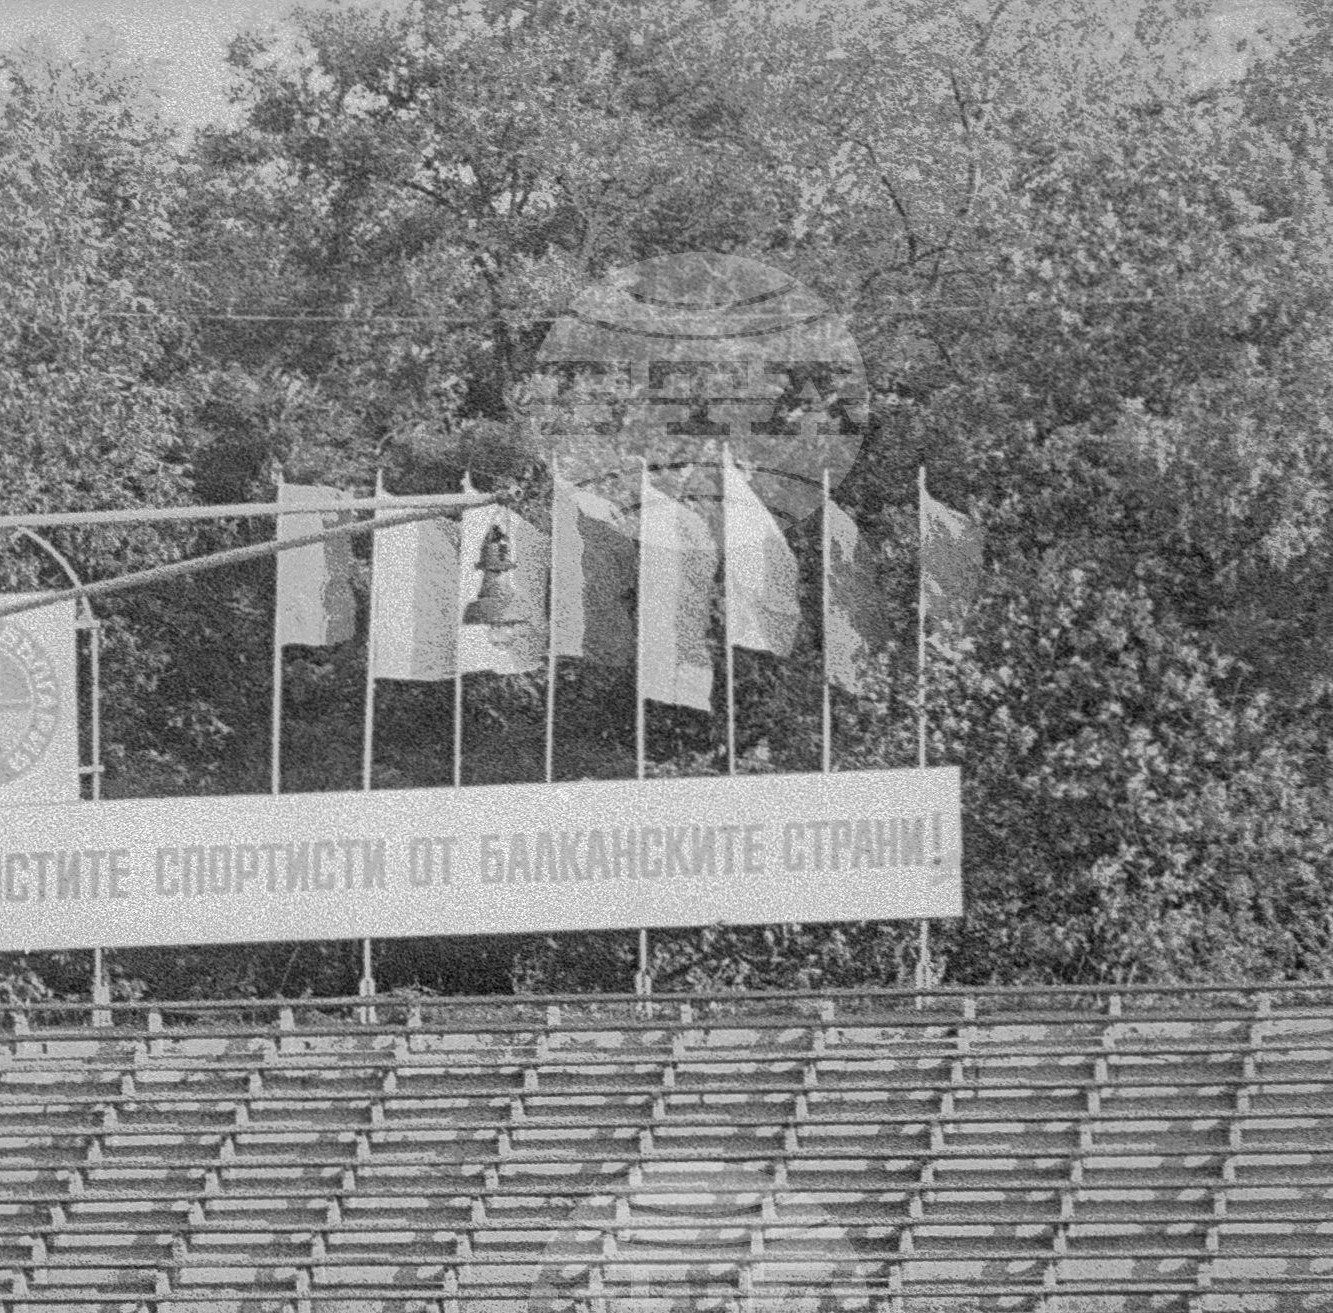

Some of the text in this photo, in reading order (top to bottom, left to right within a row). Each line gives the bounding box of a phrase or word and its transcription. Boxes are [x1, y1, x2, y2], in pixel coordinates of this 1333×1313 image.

[154, 839, 386, 898] СПОРТИСТИ
[408, 835, 457, 888] ОТ
[481, 822, 764, 885] БАЛКАНСКИТЕ
[783, 815, 943, 873] СТРАНИ!
